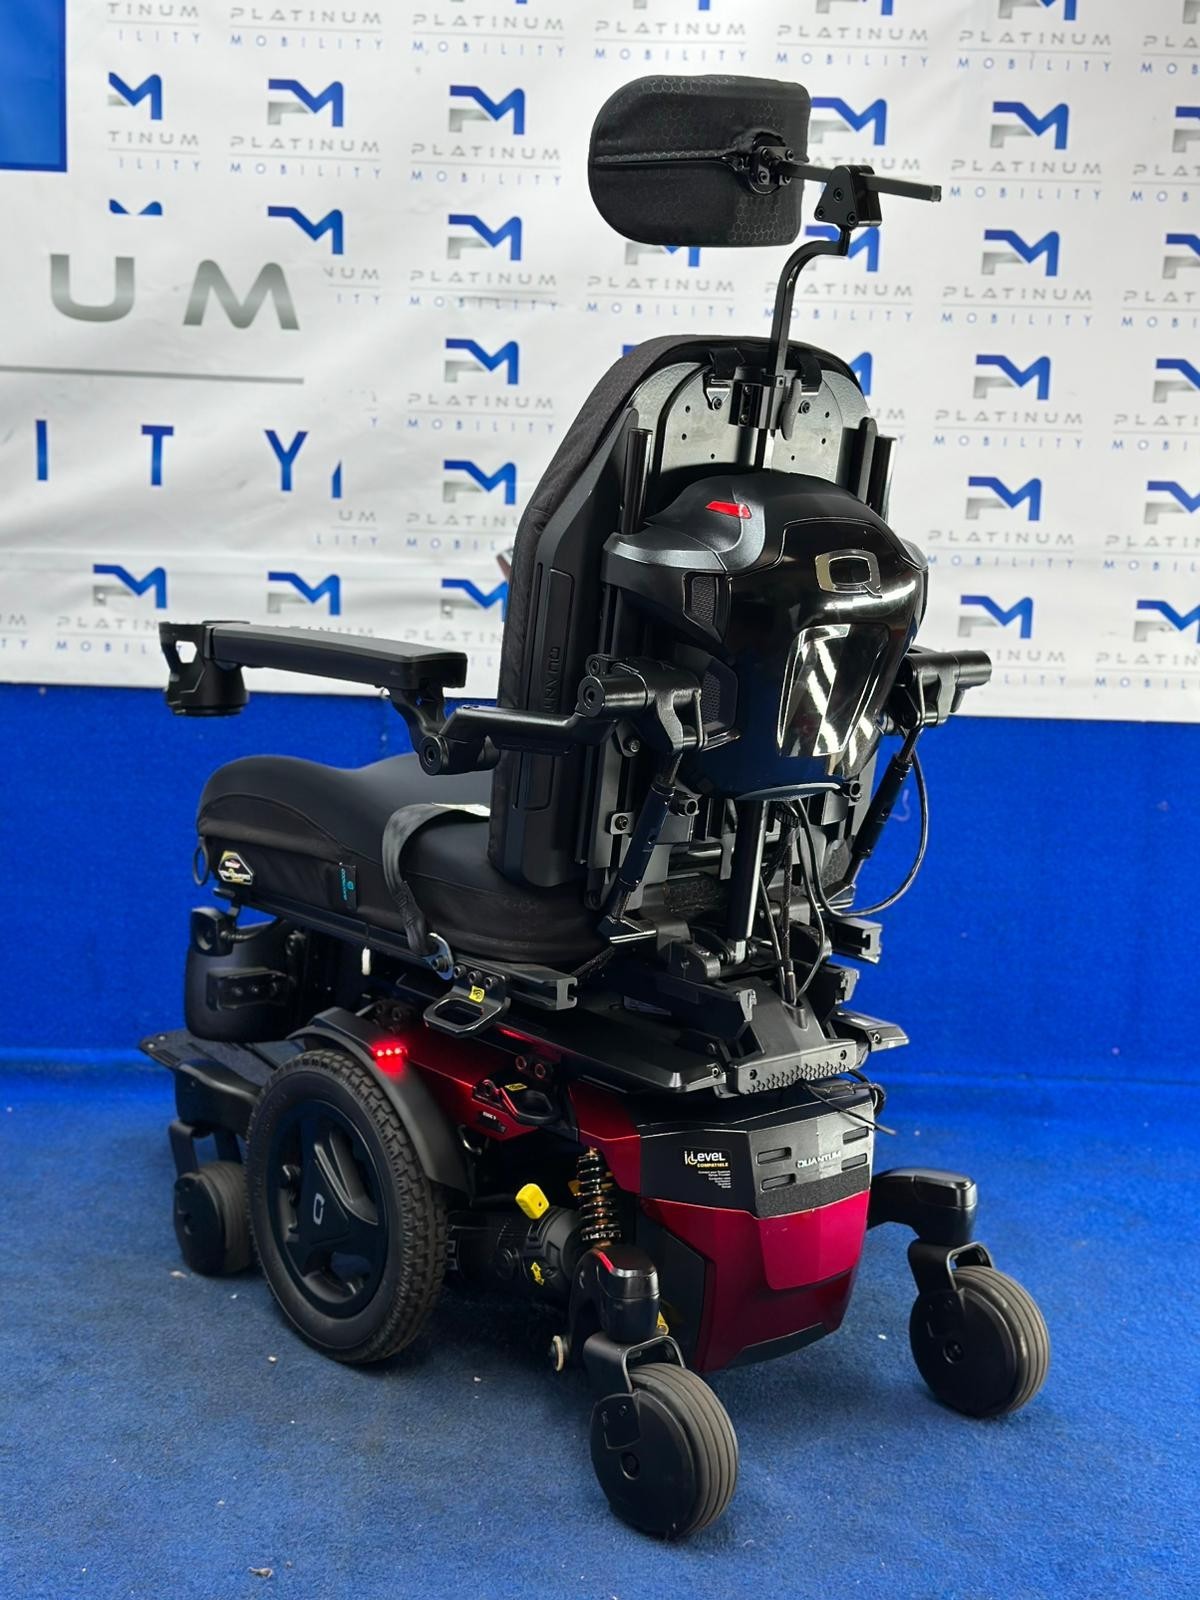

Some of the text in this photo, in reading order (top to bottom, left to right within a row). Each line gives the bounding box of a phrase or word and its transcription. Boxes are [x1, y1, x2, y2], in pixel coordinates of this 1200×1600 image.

[230, 7, 381, 25] PLATINUM
[412, 14, 563, 31] PLATINUM
[595, 20, 746, 36] PLATINUM
[776, 25, 928, 42] PLATINUM
[230, 35, 382, 50] MOBILITY
[959, 30, 1111, 46] PLATINUM
[412, 41, 563, 57] MOBILITY
[594, 48, 746, 62] MOBILITY
[776, 53, 928, 68] MOBILITY
[956, 58, 1111, 73] MOBILITY
[230, 136, 380, 153] PLATINUM
[411, 143, 561, 161] PLATINUM
[230, 163, 381, 179] MOBILITY
[951, 159, 1101, 175] PLATINUM
[411, 171, 561, 186] MOBILITY
[949, 185, 1102, 201] MOBILITY
[409, 270, 557, 287] PLATINUM
[587, 275, 734, 293] PLATINUM
[765, 281, 913, 297] PATINUM
[942, 285, 1092, 302] PLATINUM
[409, 296, 558, 311] MOBILITY
[586, 302, 735, 317] MOBILITY
[941, 312, 1091, 327] MOBILITY
[407, 393, 554, 409] PLATINUM
[935, 409, 1083, 425] PLATINUM
[407, 419, 553, 433] MOBILITY
[933, 434, 1083, 449] MOBILITY
[406, 538, 496, 551] MOBIL
[928, 530, 1075, 545] PLATINUM
[927, 555, 1074, 569] MOBILITY
[796, 1150, 842, 1169] QUANTUM
